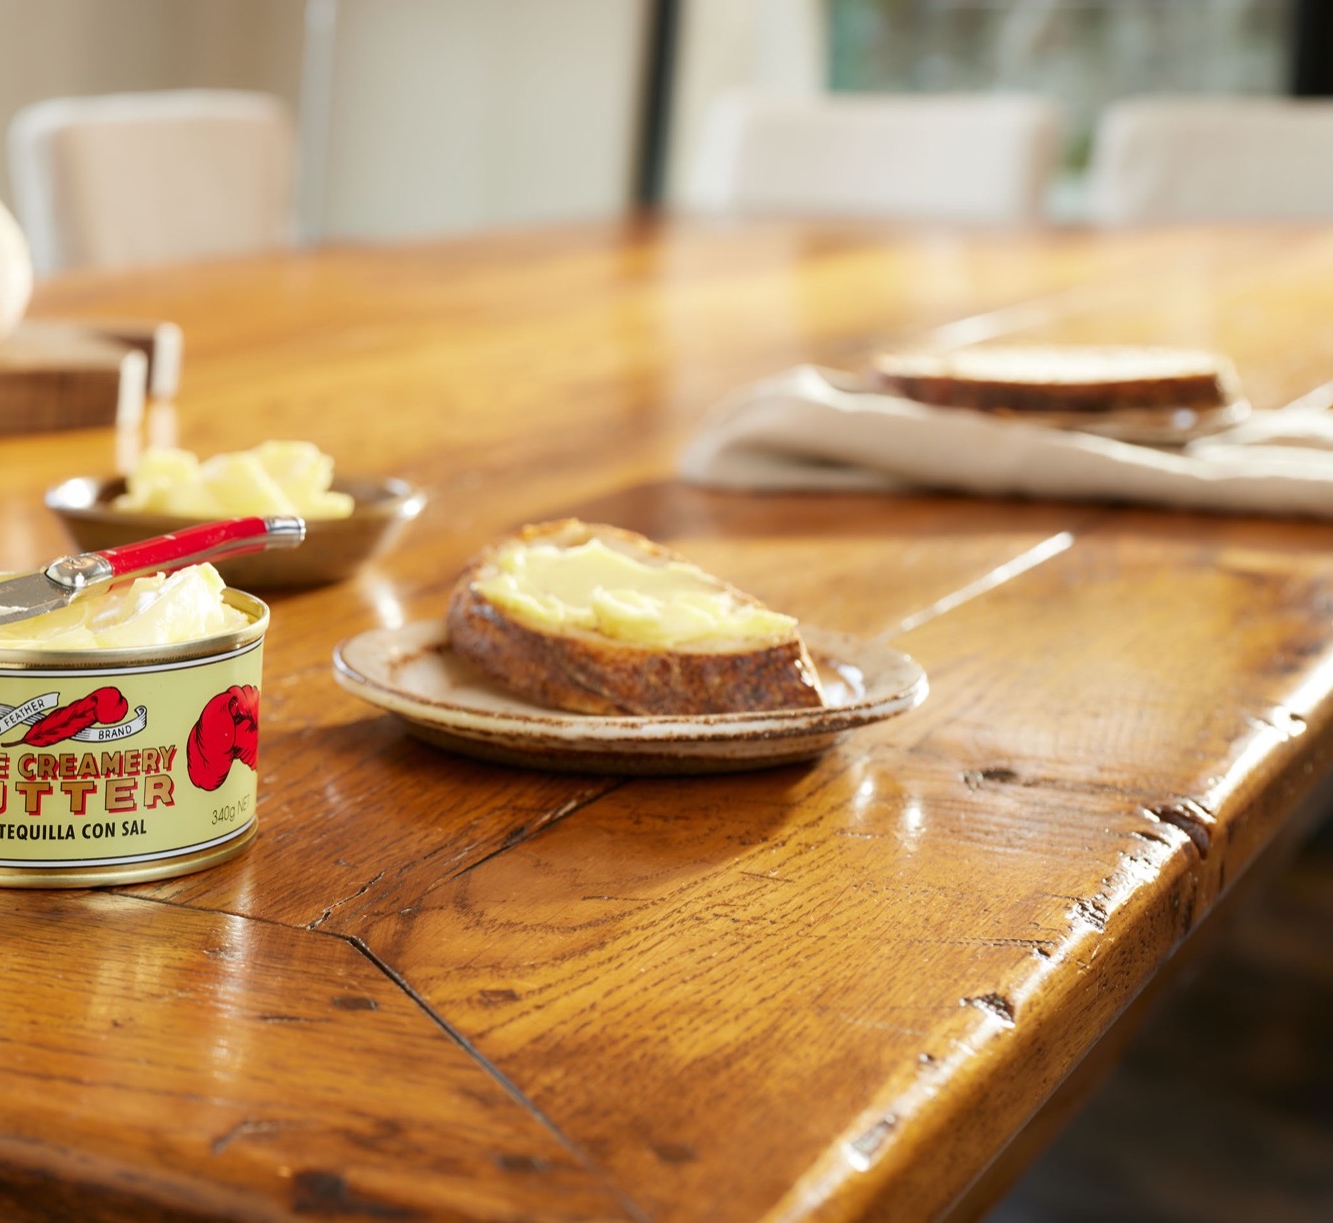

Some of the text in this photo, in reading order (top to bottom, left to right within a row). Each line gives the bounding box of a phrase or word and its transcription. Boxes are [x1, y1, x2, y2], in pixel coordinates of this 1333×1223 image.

[5, 699, 46, 727] FEATHER
[98, 724, 132, 740] BRAND
[17, 744, 178, 780] CREAMERY
[211, 793, 250, 825] 340g NET
[82, 821, 116, 839] CON
[121, 819, 147, 836] SAL
